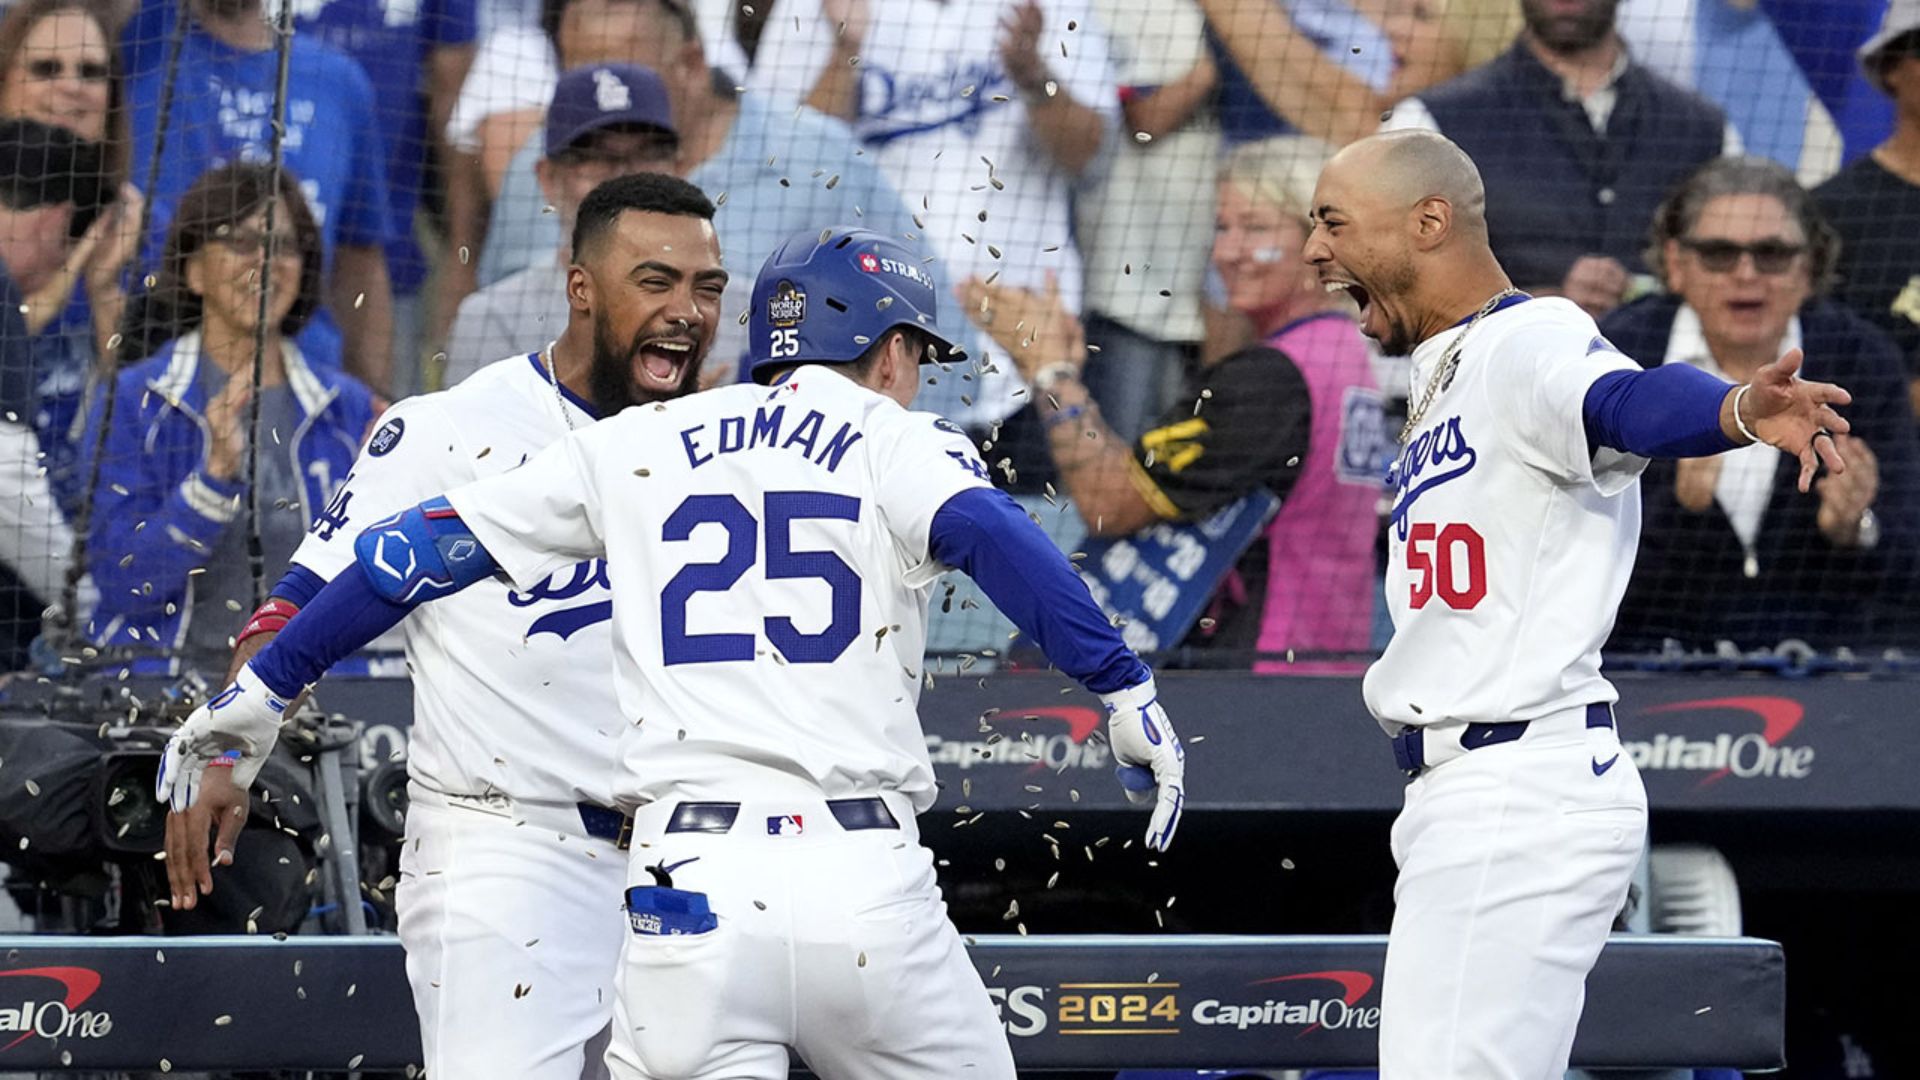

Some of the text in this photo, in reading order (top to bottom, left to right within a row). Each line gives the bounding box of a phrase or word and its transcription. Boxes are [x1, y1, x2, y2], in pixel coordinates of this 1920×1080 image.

[770, 329, 799, 358] 25
[680, 405, 863, 473] EDMAN
[660, 490, 861, 666] 25
[1406, 523, 1487, 609] 50
[1058, 994, 1181, 1023] 2024
